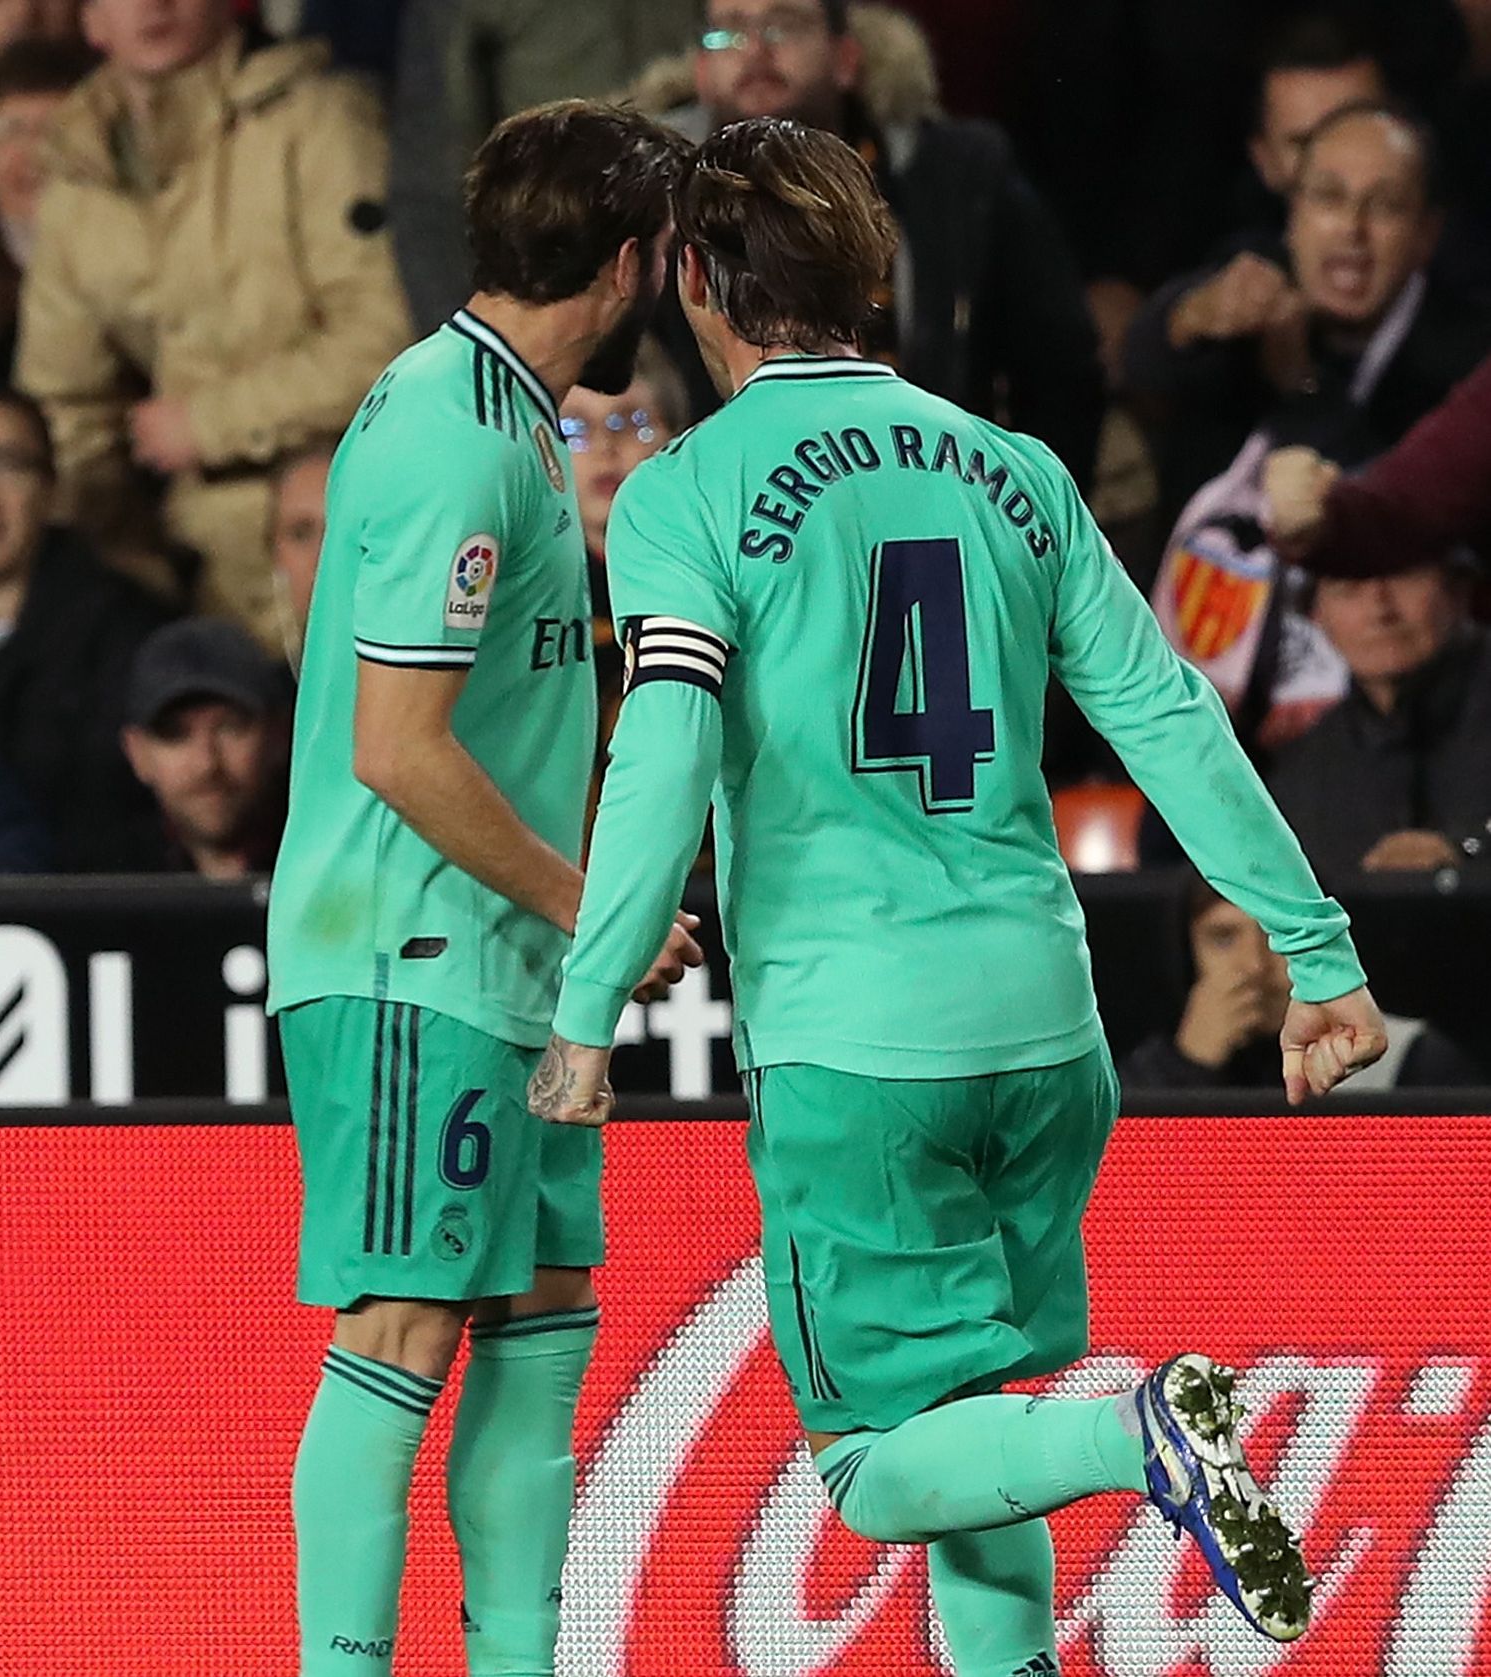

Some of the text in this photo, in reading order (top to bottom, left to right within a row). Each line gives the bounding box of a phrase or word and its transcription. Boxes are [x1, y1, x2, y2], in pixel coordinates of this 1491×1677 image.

[739, 424, 1059, 565] SERGIO RAMOS
[850, 536, 996, 816] 4
[437, 1087, 492, 1191] 6
